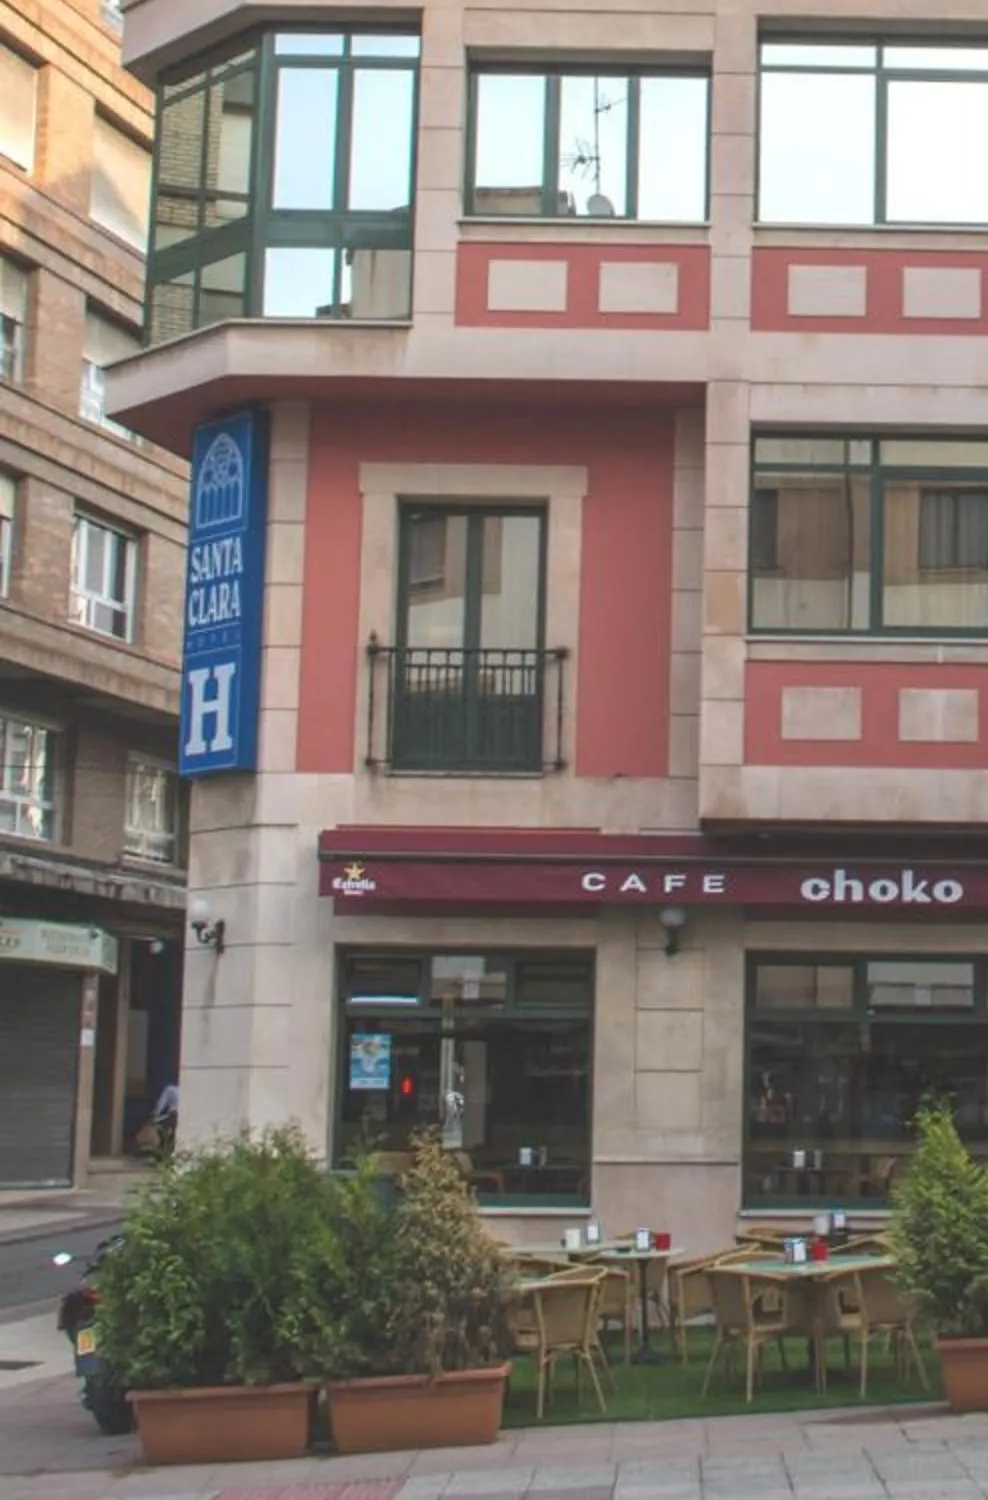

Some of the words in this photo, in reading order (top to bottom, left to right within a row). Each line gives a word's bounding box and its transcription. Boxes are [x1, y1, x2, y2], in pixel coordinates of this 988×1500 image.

[191, 536, 243, 582] SANTA
[188, 580, 242, 626] CLARA
[184, 662, 236, 757] H
[581, 873, 726, 893] CAFE
[800, 869, 964, 903] choko
